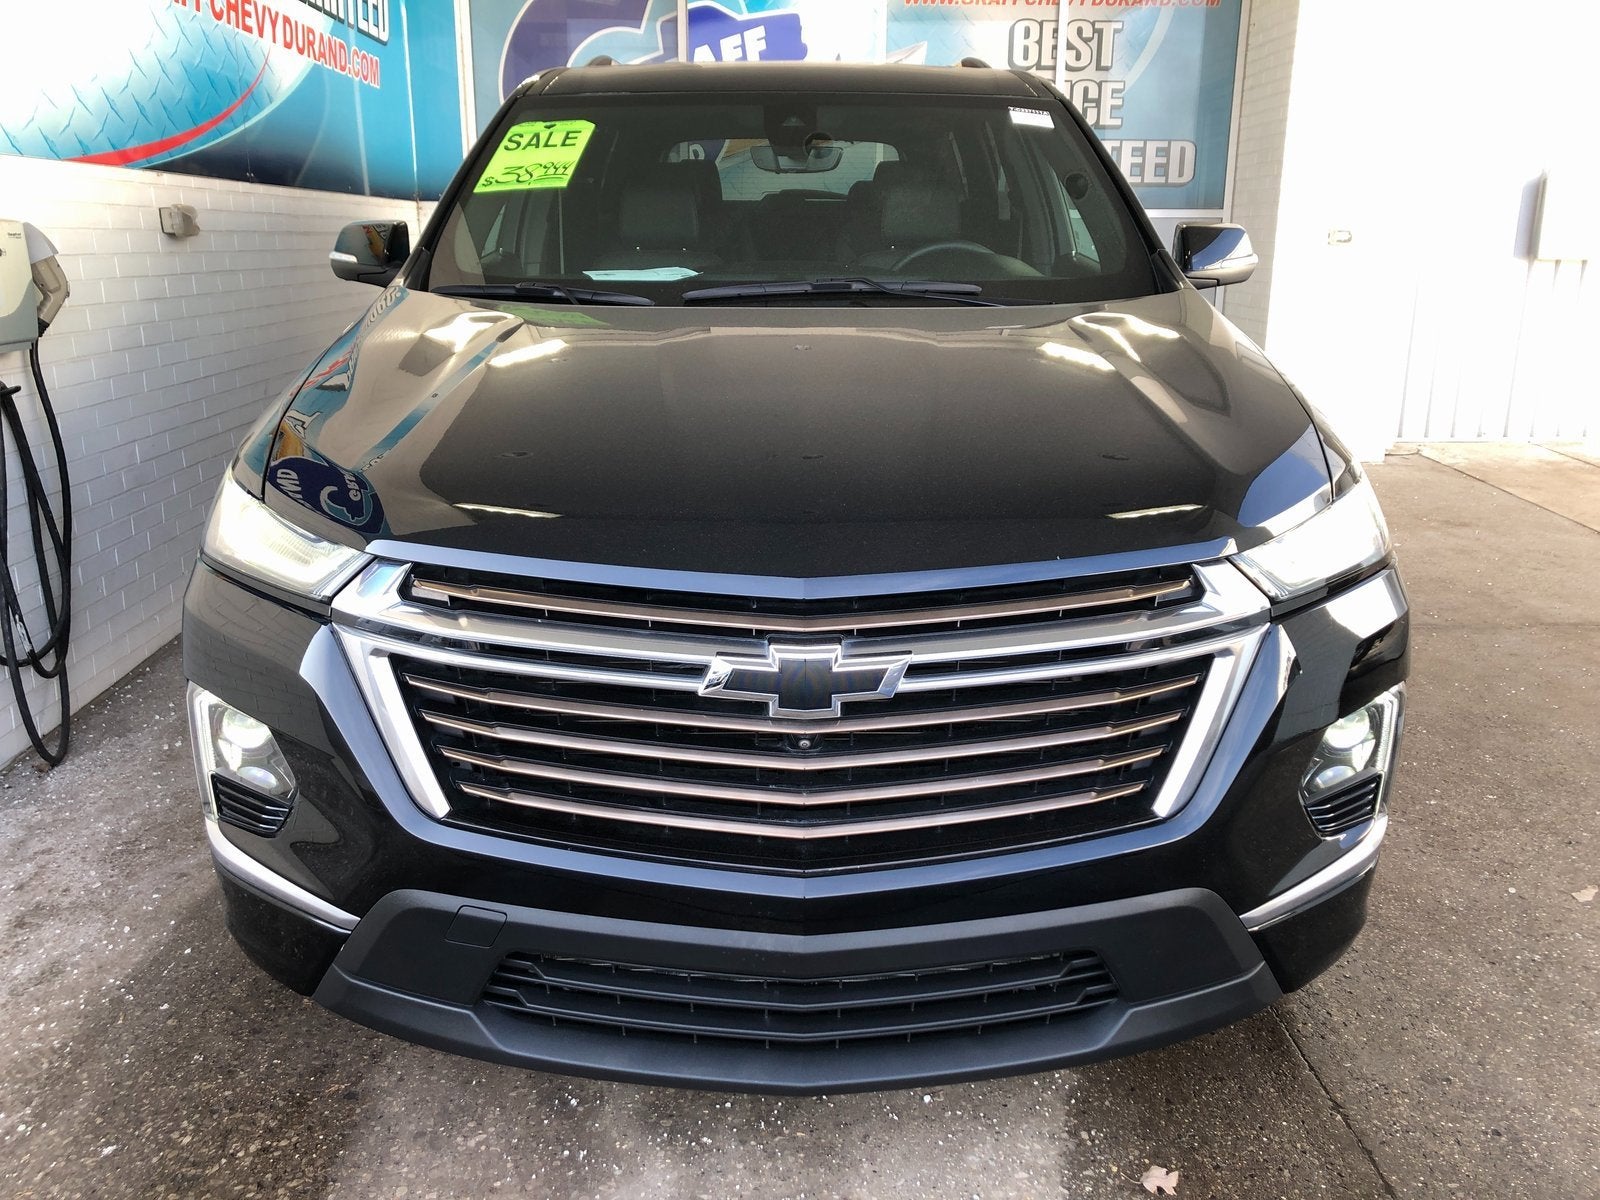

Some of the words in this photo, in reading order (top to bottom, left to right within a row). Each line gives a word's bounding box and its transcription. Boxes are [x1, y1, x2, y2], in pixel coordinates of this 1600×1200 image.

[174, 0, 380, 87] CHEVYDURAND.COM
[1010, 19, 1123, 71] BEST
[503, 130, 582, 151] SALE
